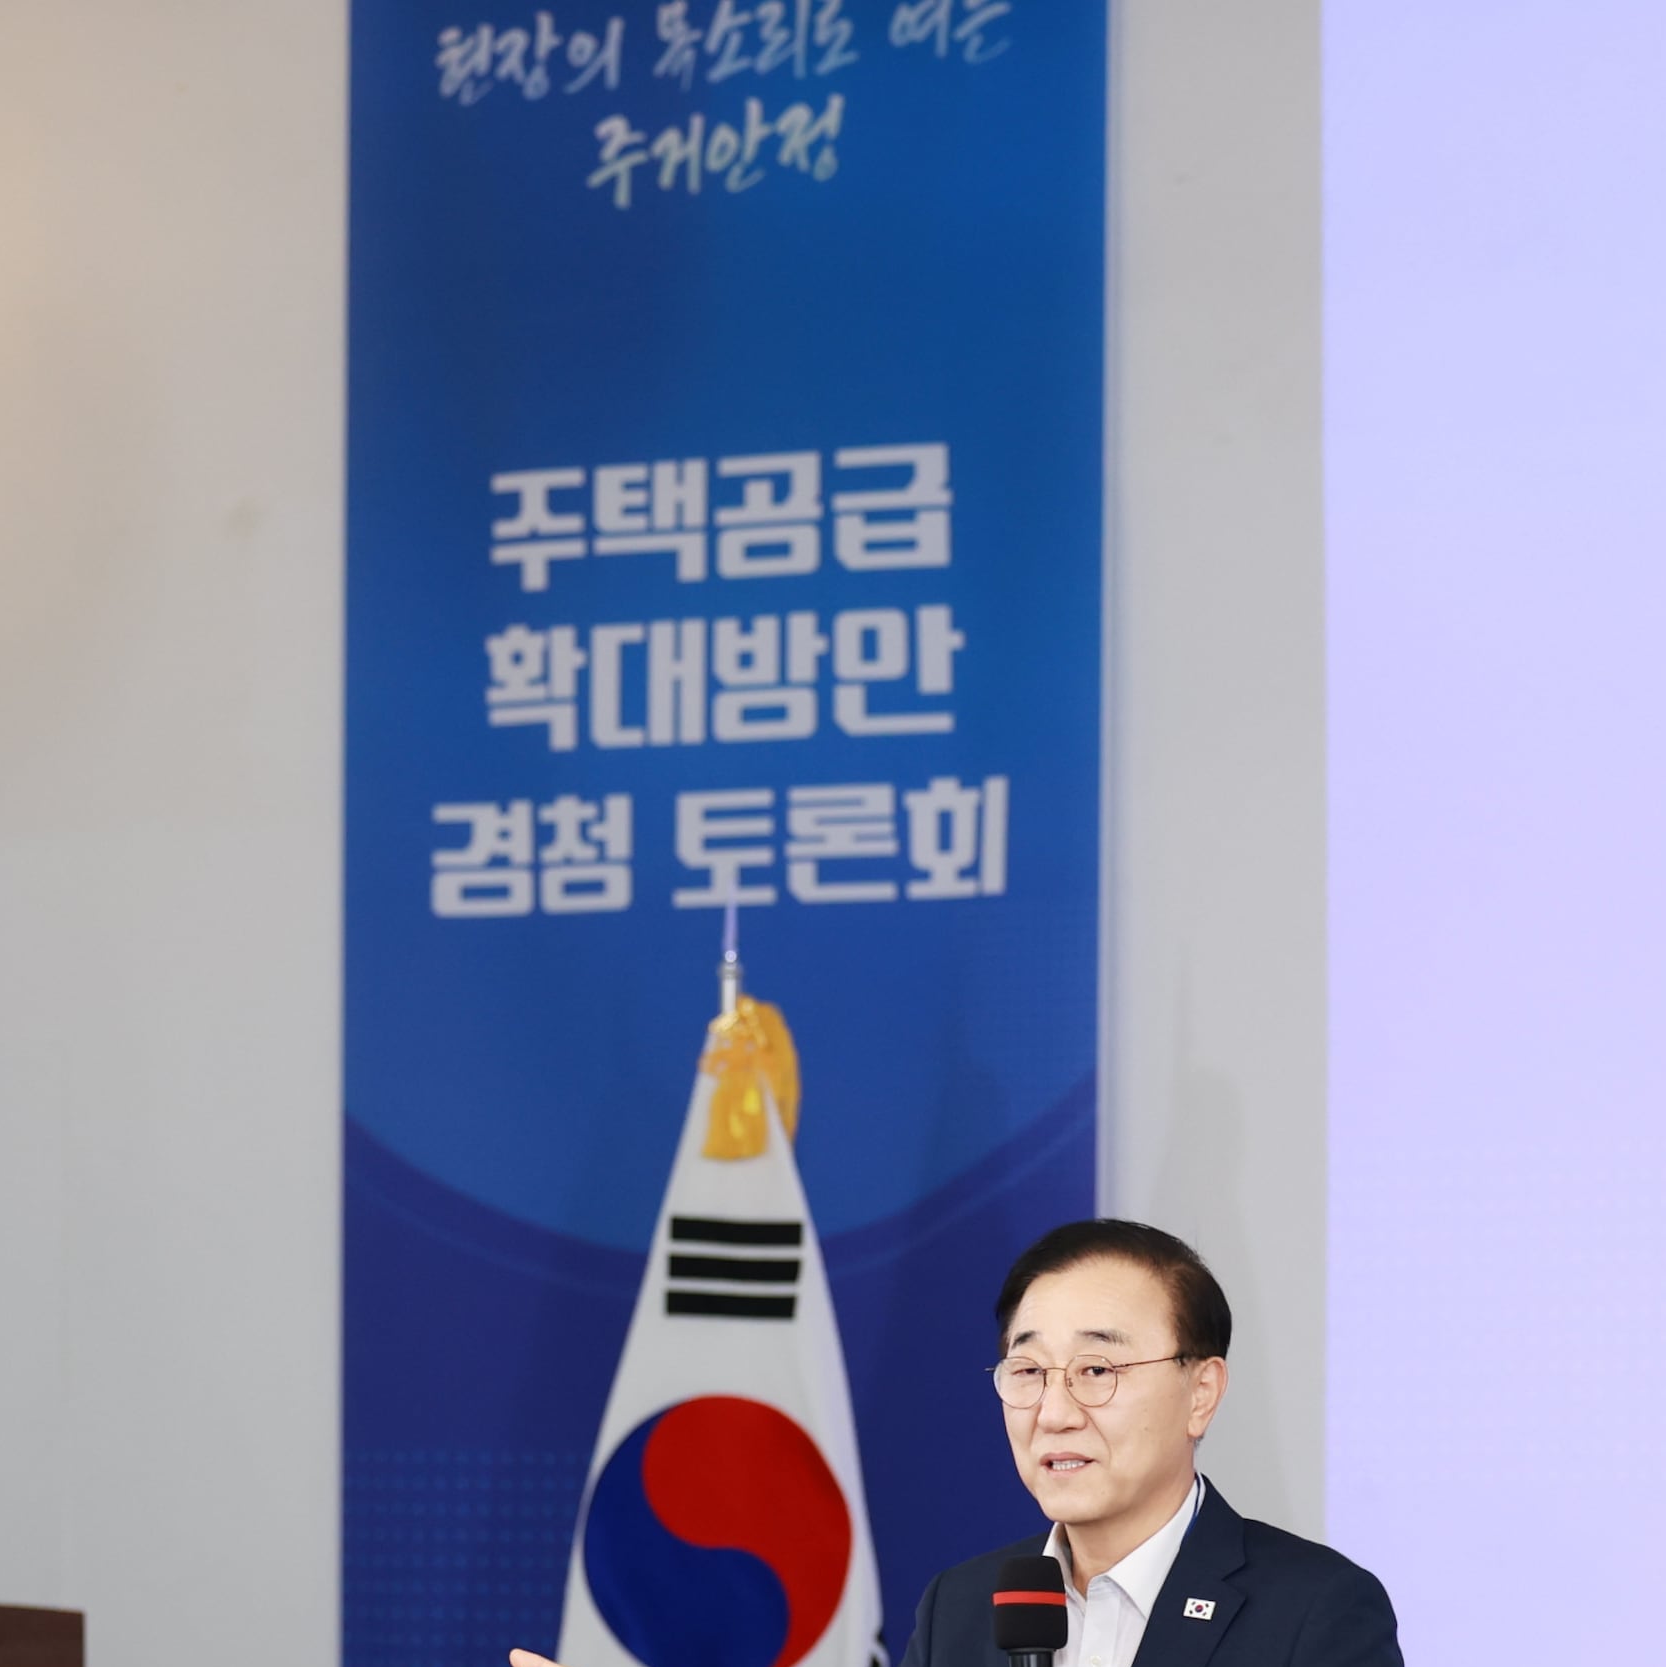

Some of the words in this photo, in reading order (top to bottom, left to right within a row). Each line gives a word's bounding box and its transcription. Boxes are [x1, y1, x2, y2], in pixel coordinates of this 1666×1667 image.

[436, 10, 625, 106] 현장의
[653, 0, 859, 91] 목소리로
[586, 92, 845, 209] 주거안정
[490, 444, 952, 592] 주택공급
[485, 606, 965, 752] 확대방안
[431, 794, 632, 917] 경청
[671, 776, 1009, 908] 토론회
